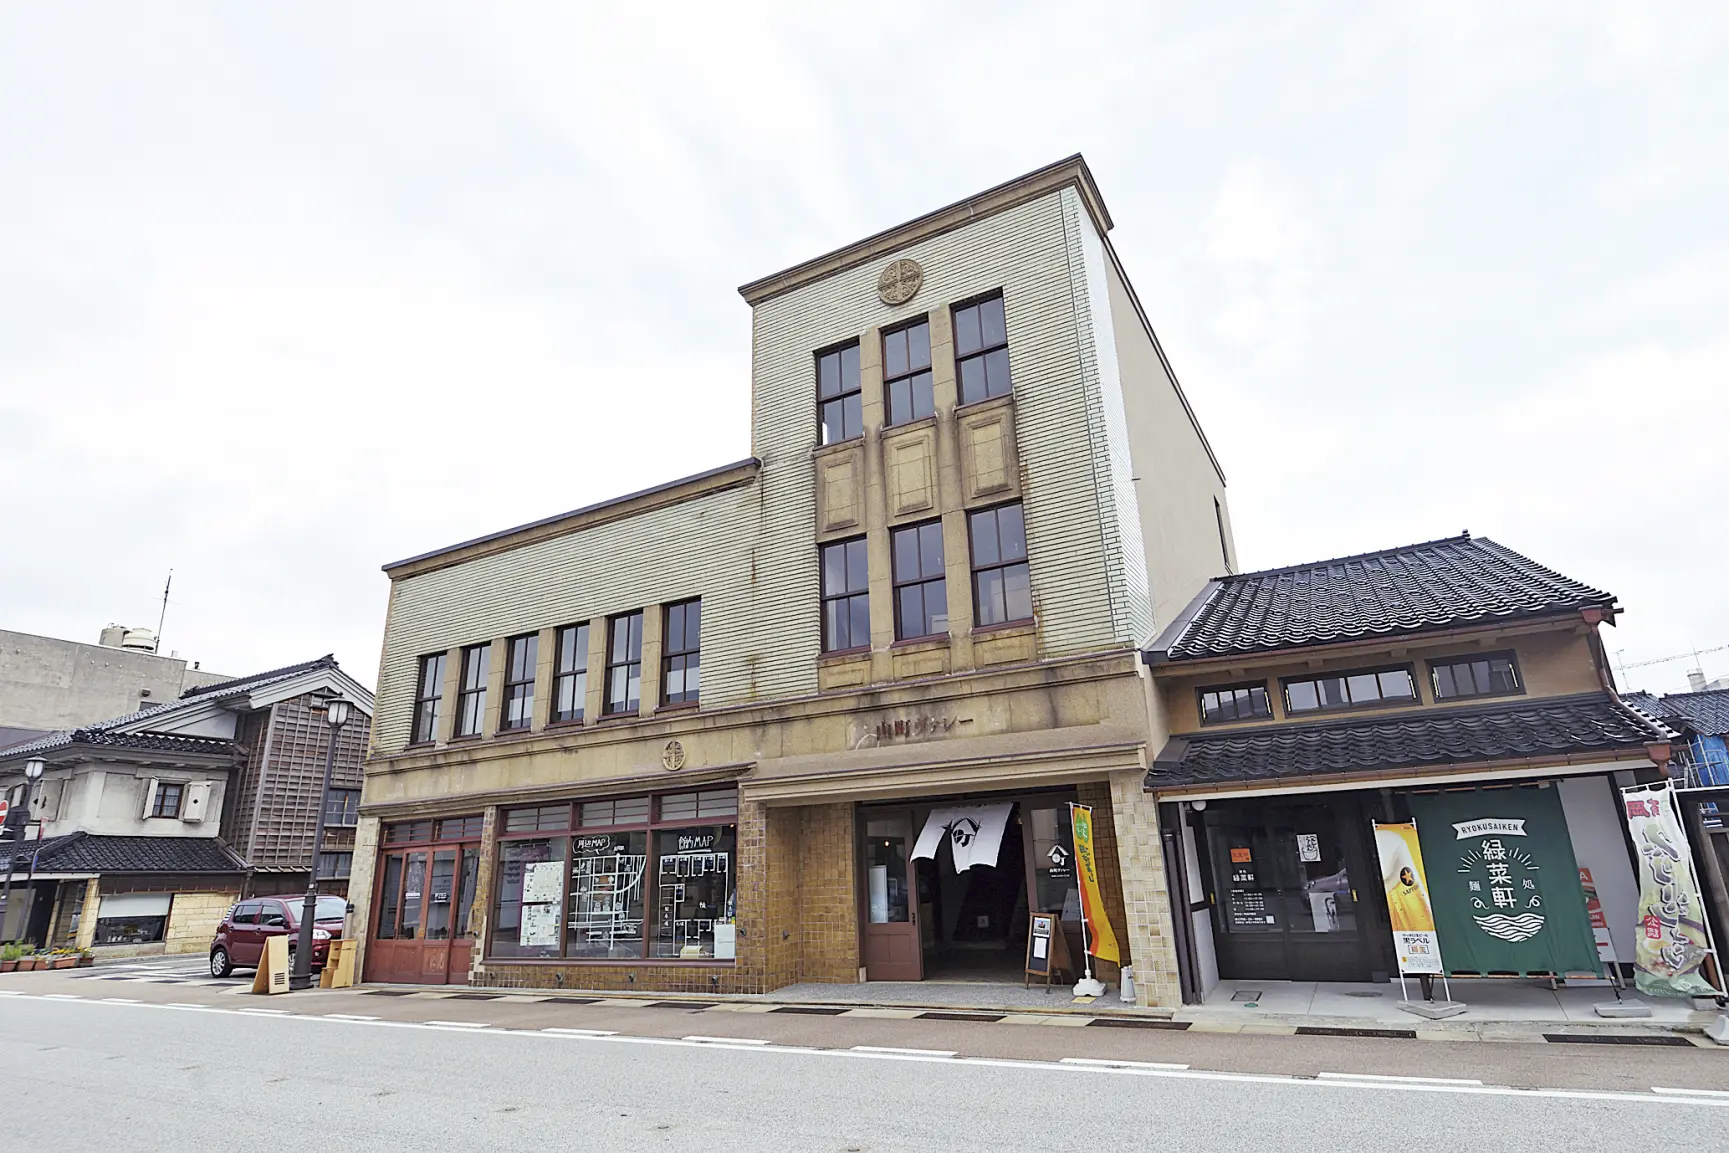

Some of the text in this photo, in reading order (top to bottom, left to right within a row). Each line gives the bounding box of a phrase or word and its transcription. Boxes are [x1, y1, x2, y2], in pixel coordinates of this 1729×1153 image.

[1461, 822, 1519, 834] RYOKUSAIKEN
[1481, 839, 1518, 909] 緑菜軒
